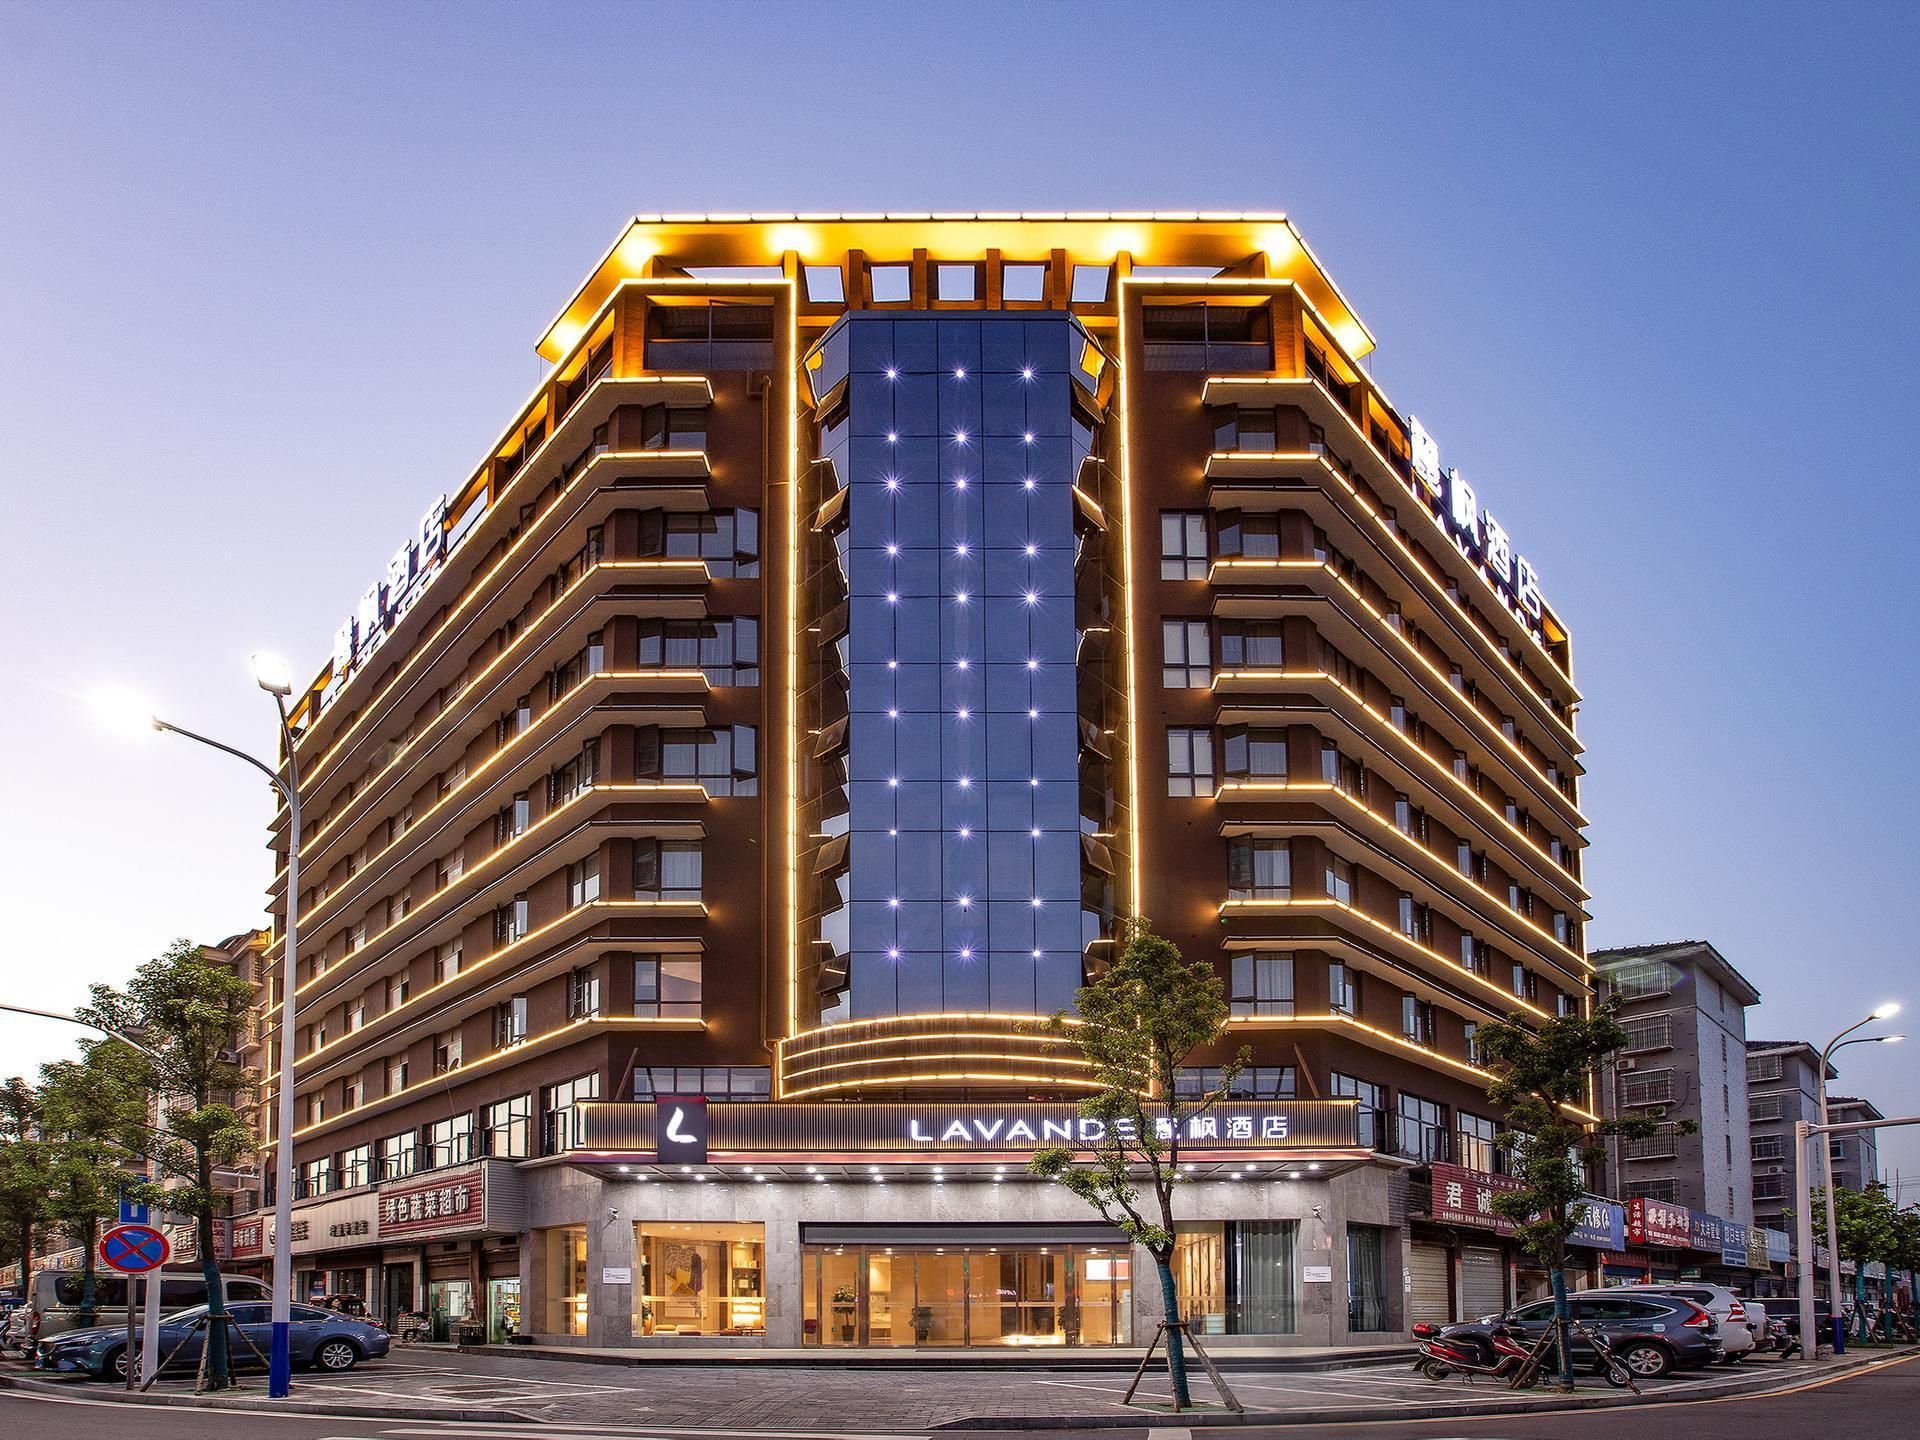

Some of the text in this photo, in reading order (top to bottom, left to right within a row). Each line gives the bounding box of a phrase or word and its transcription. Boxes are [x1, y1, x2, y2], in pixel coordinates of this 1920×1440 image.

[385, 1184, 471, 1223] 绿色蔬菜超市
